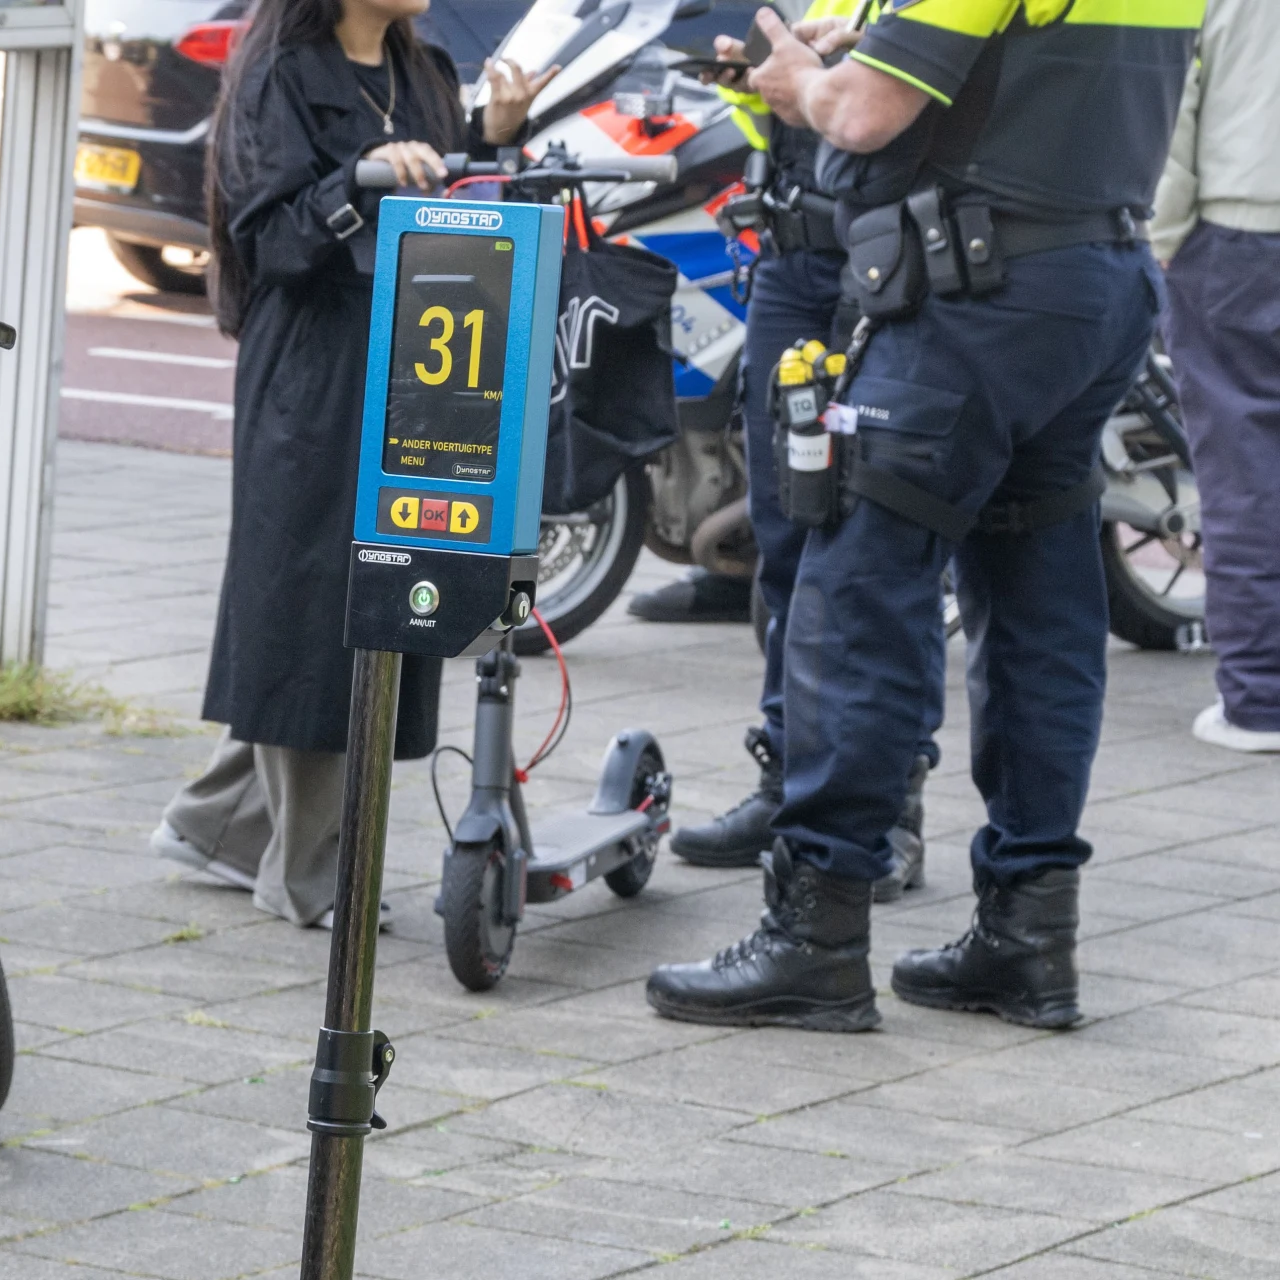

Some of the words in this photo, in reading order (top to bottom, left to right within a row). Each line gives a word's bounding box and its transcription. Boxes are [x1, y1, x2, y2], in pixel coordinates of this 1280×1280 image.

[414, 305, 485, 389] 31
[401, 437, 431, 451] ANDER
[432, 440, 493, 455] VOERTUIGTYPE
[400, 455, 426, 467] MENU
[423, 508, 446, 523] OK
[408, 618, 437, 629] AAN/UIT
